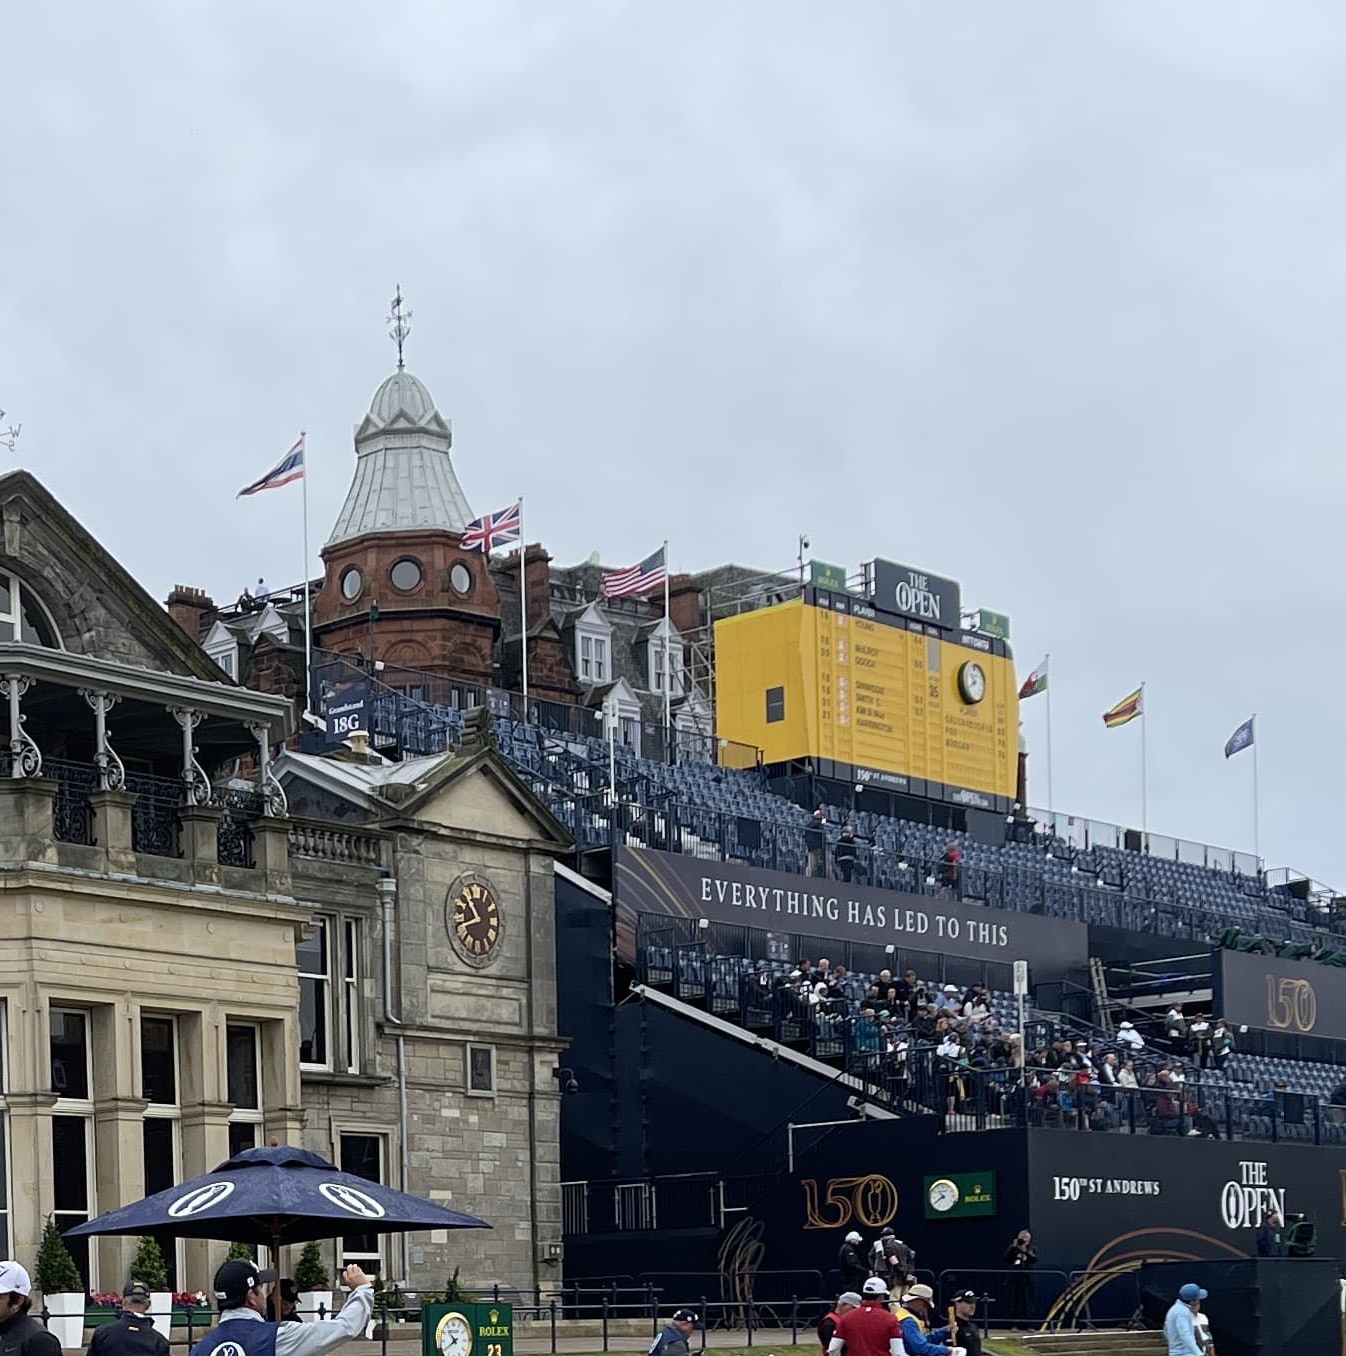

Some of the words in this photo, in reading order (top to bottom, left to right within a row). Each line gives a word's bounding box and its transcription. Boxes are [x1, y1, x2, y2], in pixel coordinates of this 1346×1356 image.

[908, 571, 929, 591] THE
[895, 580, 941, 620] OPEN
[333, 714, 360, 734] 18G
[701, 877, 840, 920] EVERYTHING
[847, 900, 887, 928] HAS
[894, 908, 929, 934] LED
[935, 915, 960, 939] TO
[966, 920, 1009, 946] THIS
[1265, 974, 1317, 1031] 150
[1088, 1178, 1104, 1194] ST
[1105, 1179, 1160, 1196] ANDREWS
[1239, 1161, 1268, 1186] THE
[801, 1174, 898, 1229] 150
[1221, 1180, 1285, 1229] OPEN
[479, 1326, 510, 1337] ROLEX
